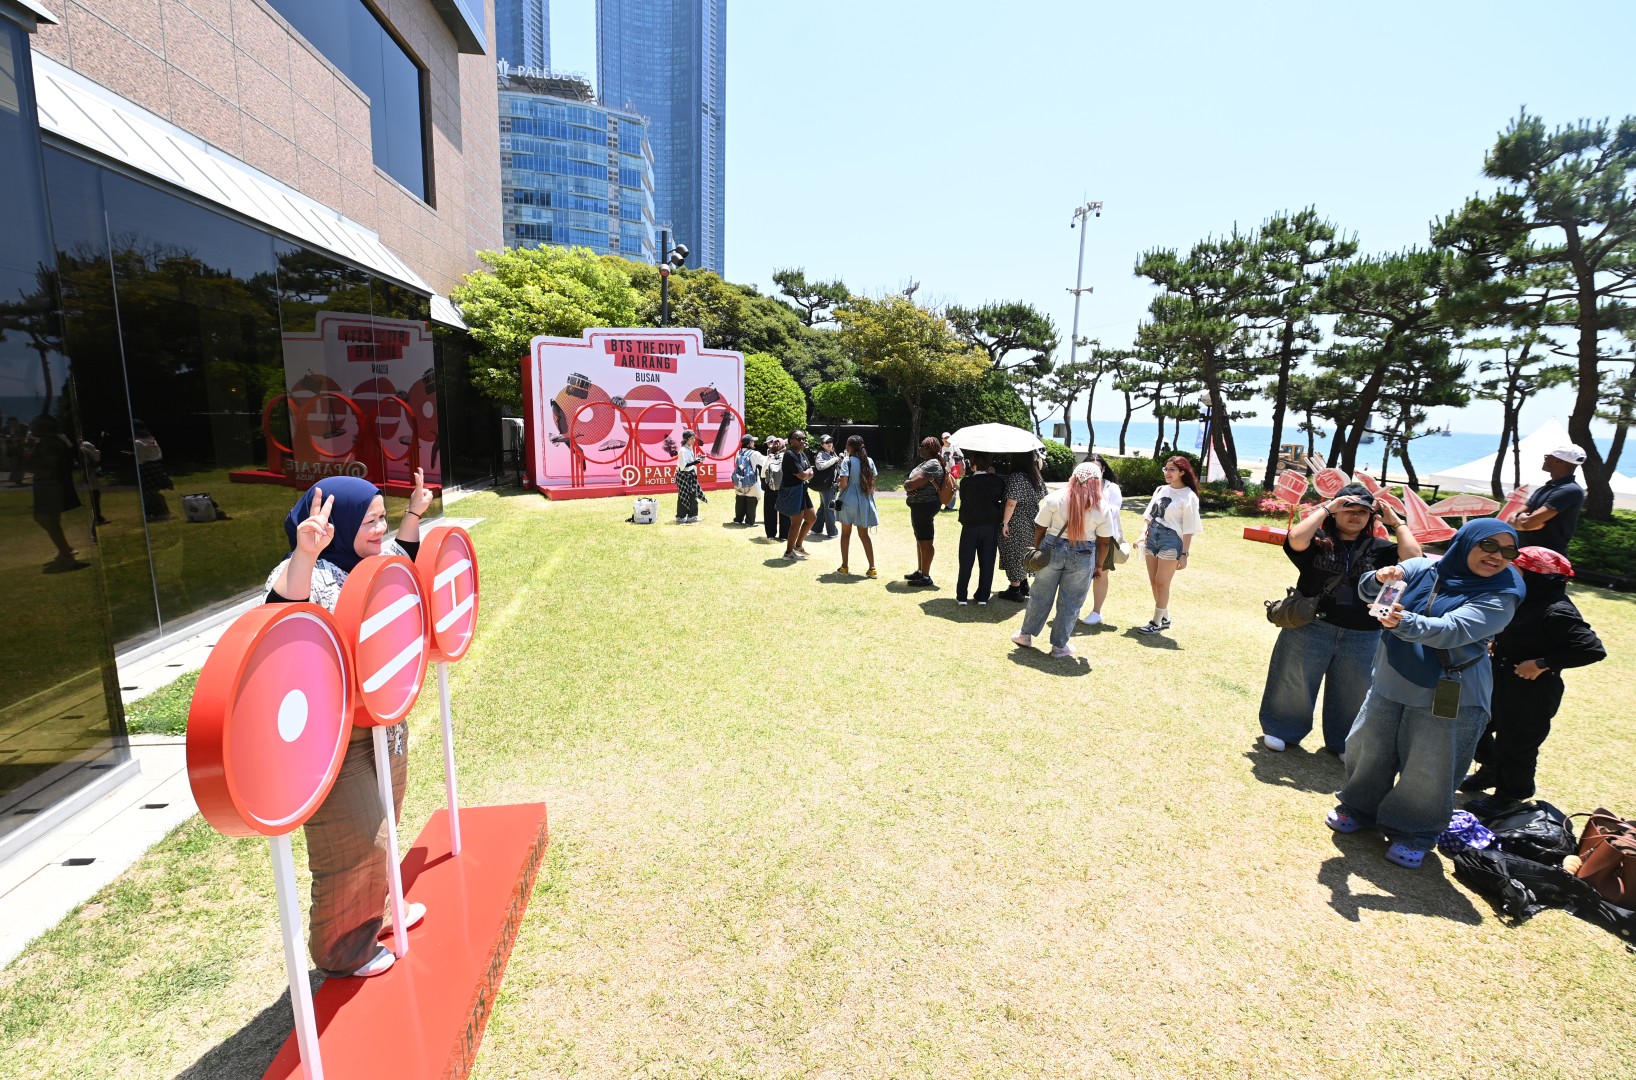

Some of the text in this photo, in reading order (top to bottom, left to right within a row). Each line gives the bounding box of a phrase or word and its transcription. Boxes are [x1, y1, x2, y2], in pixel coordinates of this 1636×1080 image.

[611, 339, 680, 355] BTS THE CITY
[621, 354, 670, 369] ARIRANG
[635, 372, 660, 383] BUSAN
